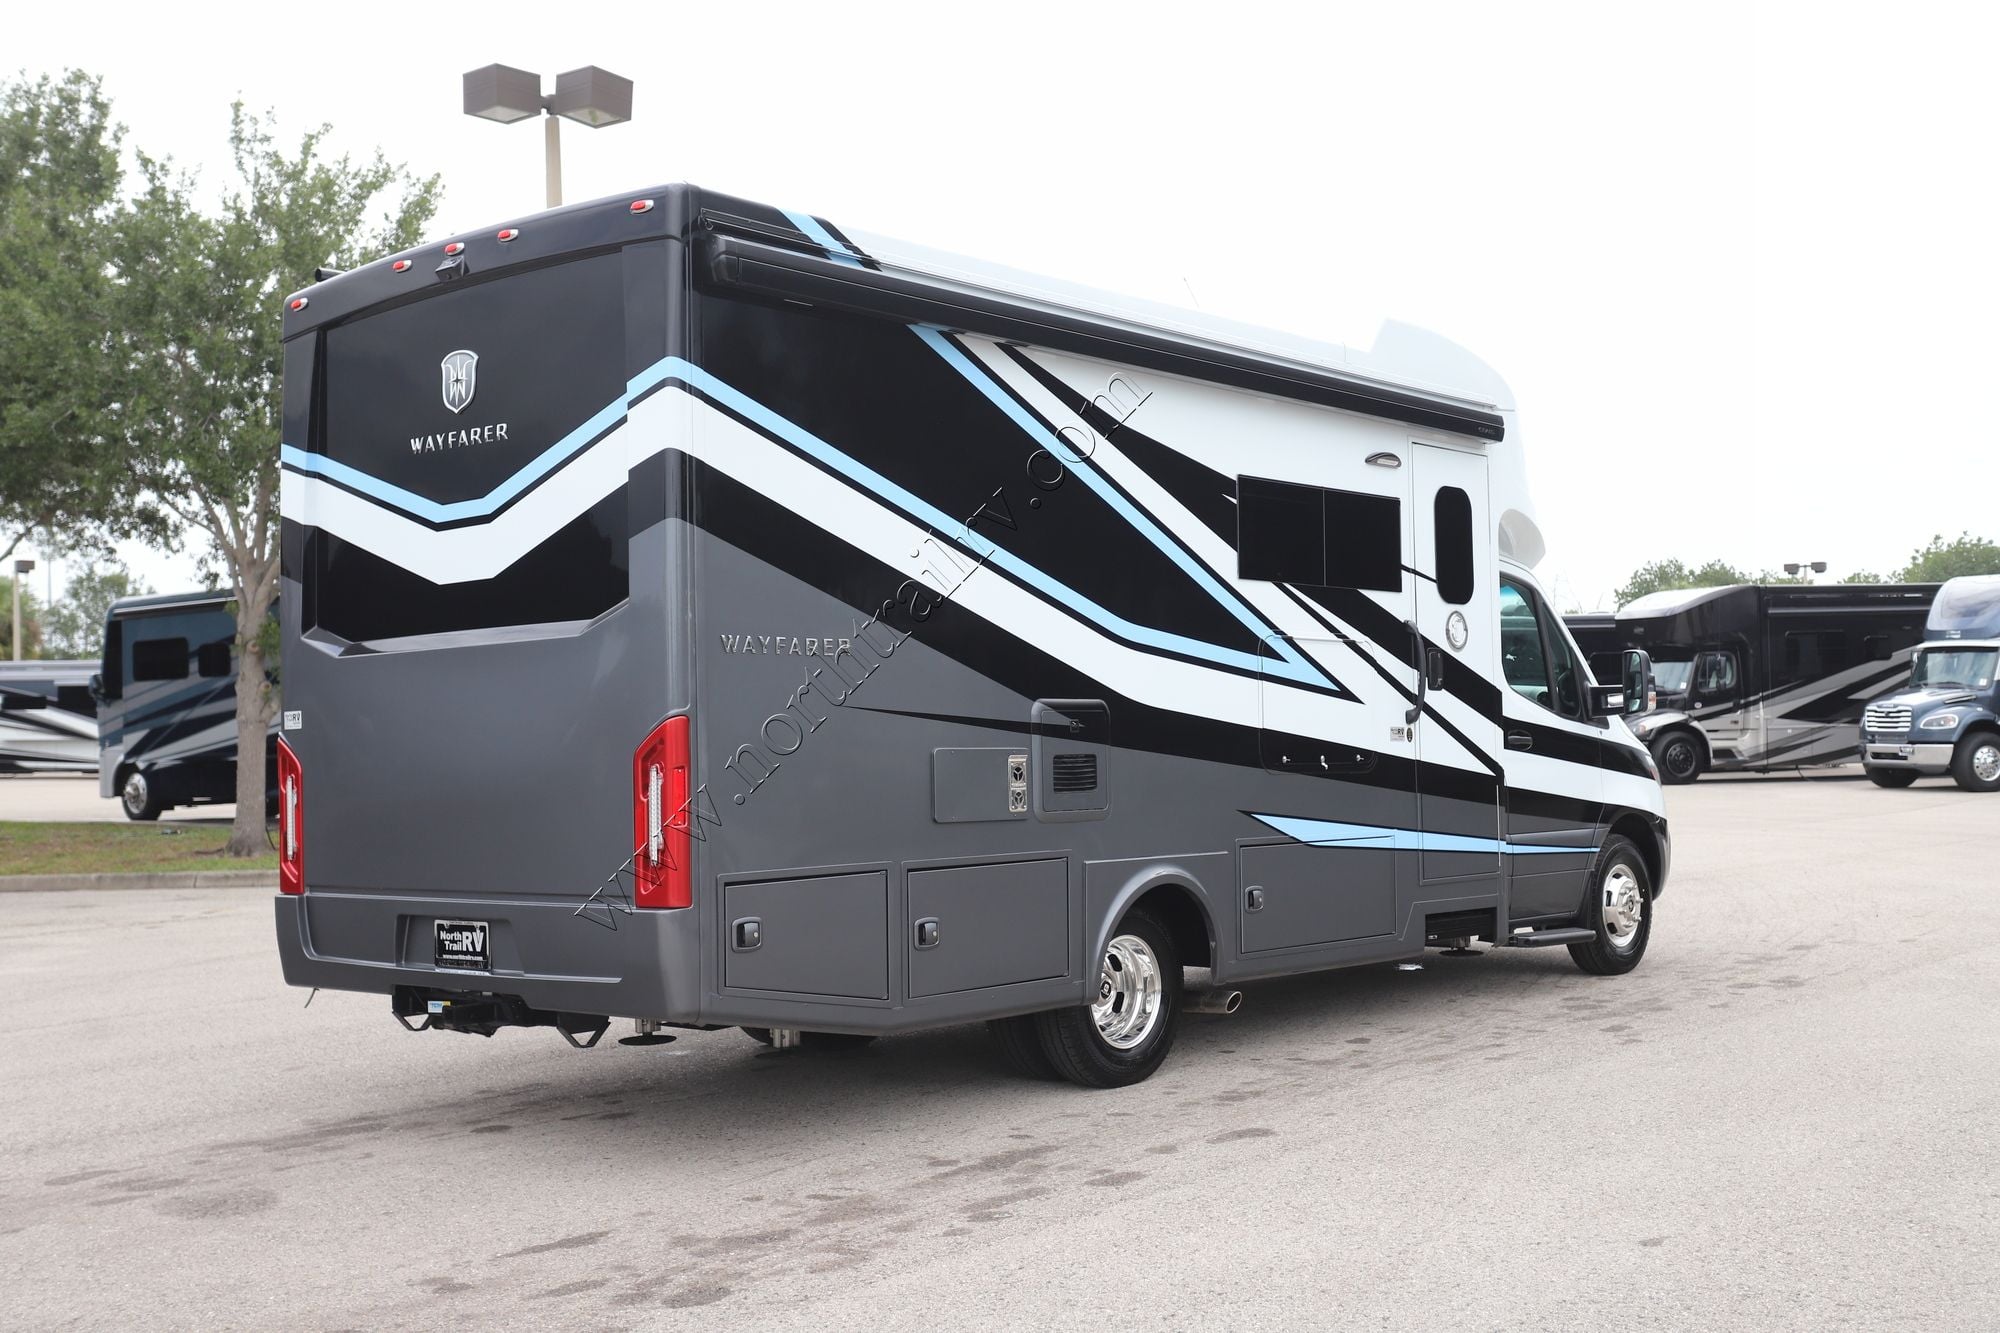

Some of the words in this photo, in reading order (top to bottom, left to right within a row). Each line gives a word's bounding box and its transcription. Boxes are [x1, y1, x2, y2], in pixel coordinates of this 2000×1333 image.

[410, 423, 508, 454] WAYFARER
[720, 634, 851, 656] WAYFARER
[440, 930, 462, 941] North
[444, 940, 462, 951] Trail
[462, 931, 484, 952] RV
